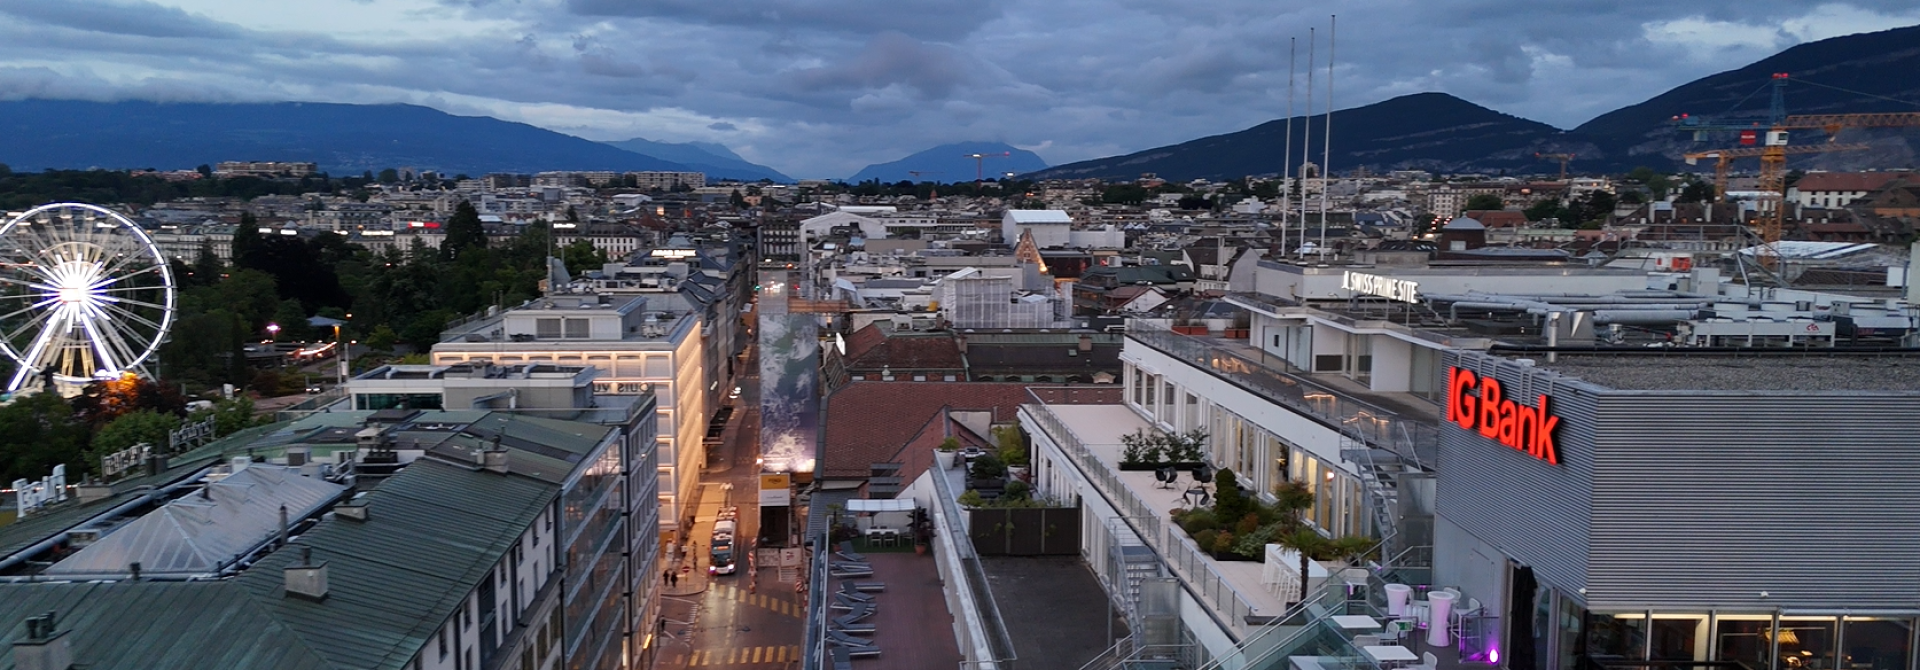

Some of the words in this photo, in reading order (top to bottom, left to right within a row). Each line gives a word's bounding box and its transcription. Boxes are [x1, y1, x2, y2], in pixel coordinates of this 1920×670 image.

[1351, 272, 1374, 295] SWISS
[1374, 275, 1398, 300] PRIME
[1397, 279, 1418, 304] SITE
[1447, 366, 1476, 430] IG
[1479, 377, 1559, 465] Bank
